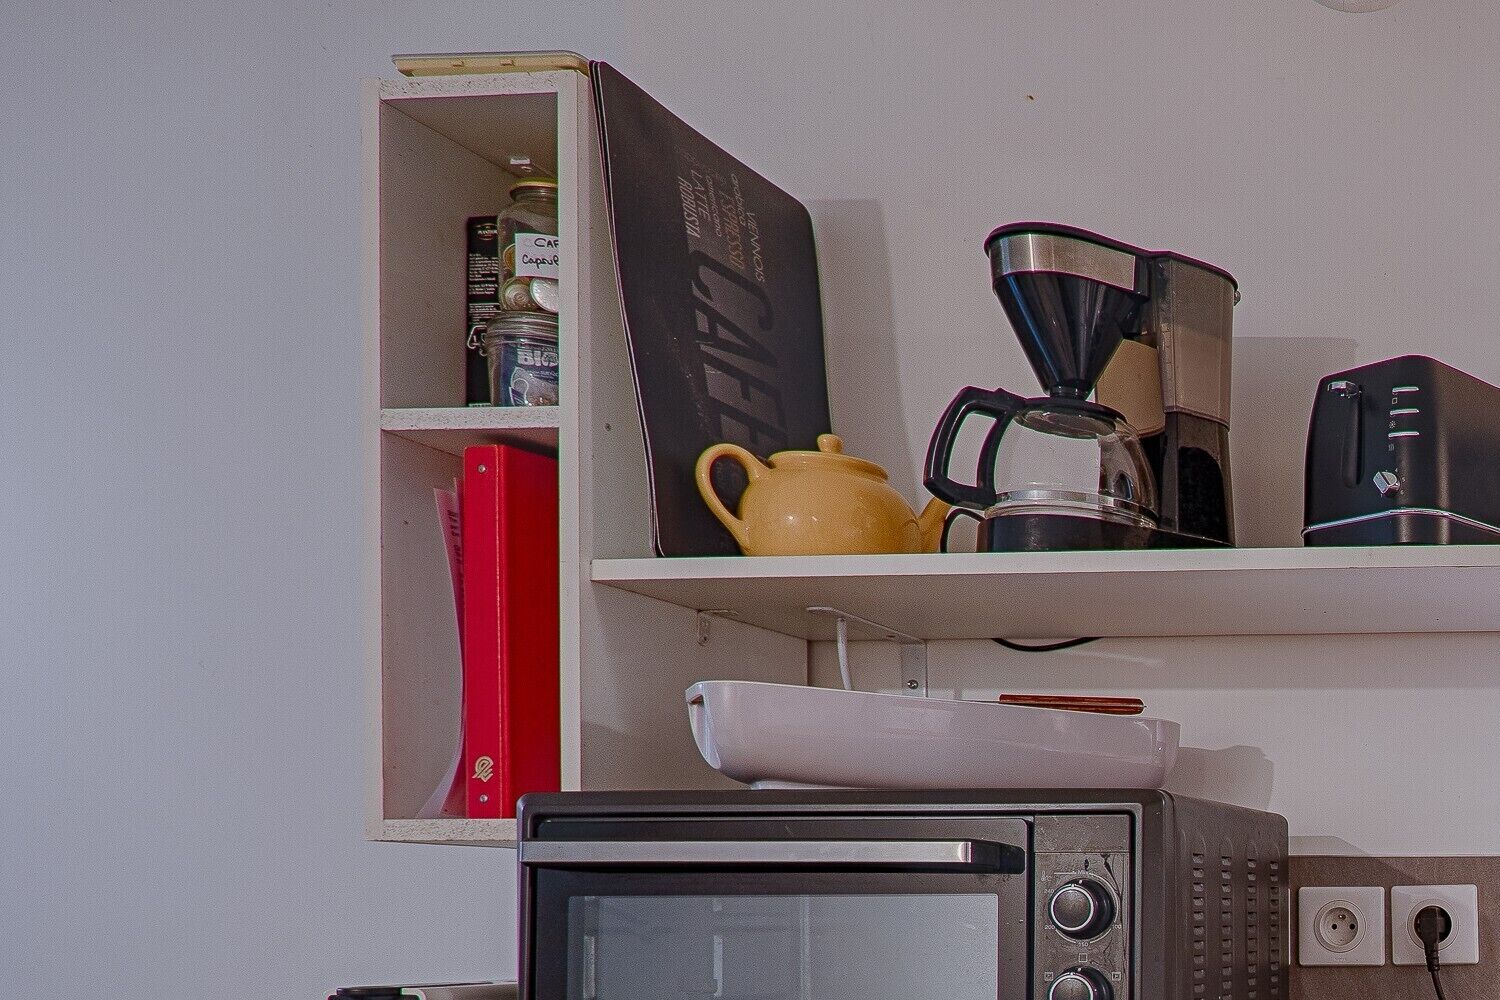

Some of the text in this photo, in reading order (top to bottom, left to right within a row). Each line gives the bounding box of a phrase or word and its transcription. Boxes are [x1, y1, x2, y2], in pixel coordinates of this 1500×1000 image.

[677, 176, 701, 239] ROBUSTA
[691, 169, 711, 222] LATTE
[731, 173, 747, 228] arabica
[719, 190, 745, 270] ESPRESSO
[746, 212, 766, 283] VIENNOIS
